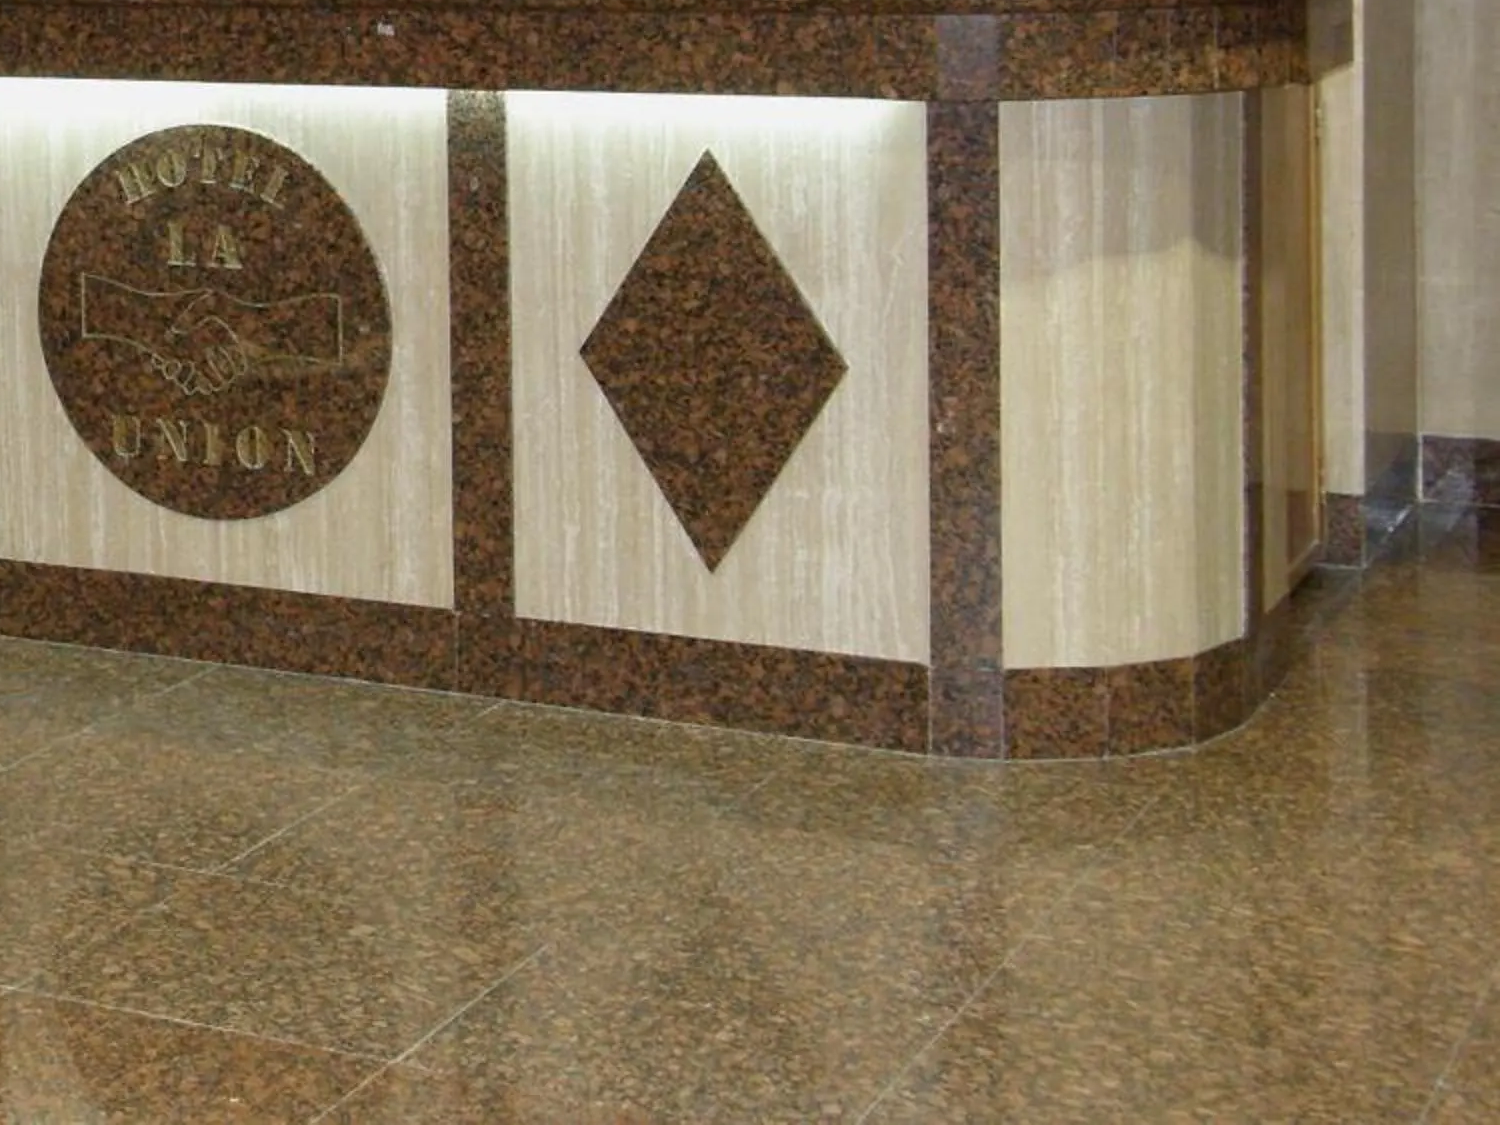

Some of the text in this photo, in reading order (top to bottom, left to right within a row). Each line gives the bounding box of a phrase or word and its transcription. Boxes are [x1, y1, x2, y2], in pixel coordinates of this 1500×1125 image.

[114, 133, 290, 210] HOTEL
[166, 221, 243, 270] LA
[111, 415, 317, 476] UNION
